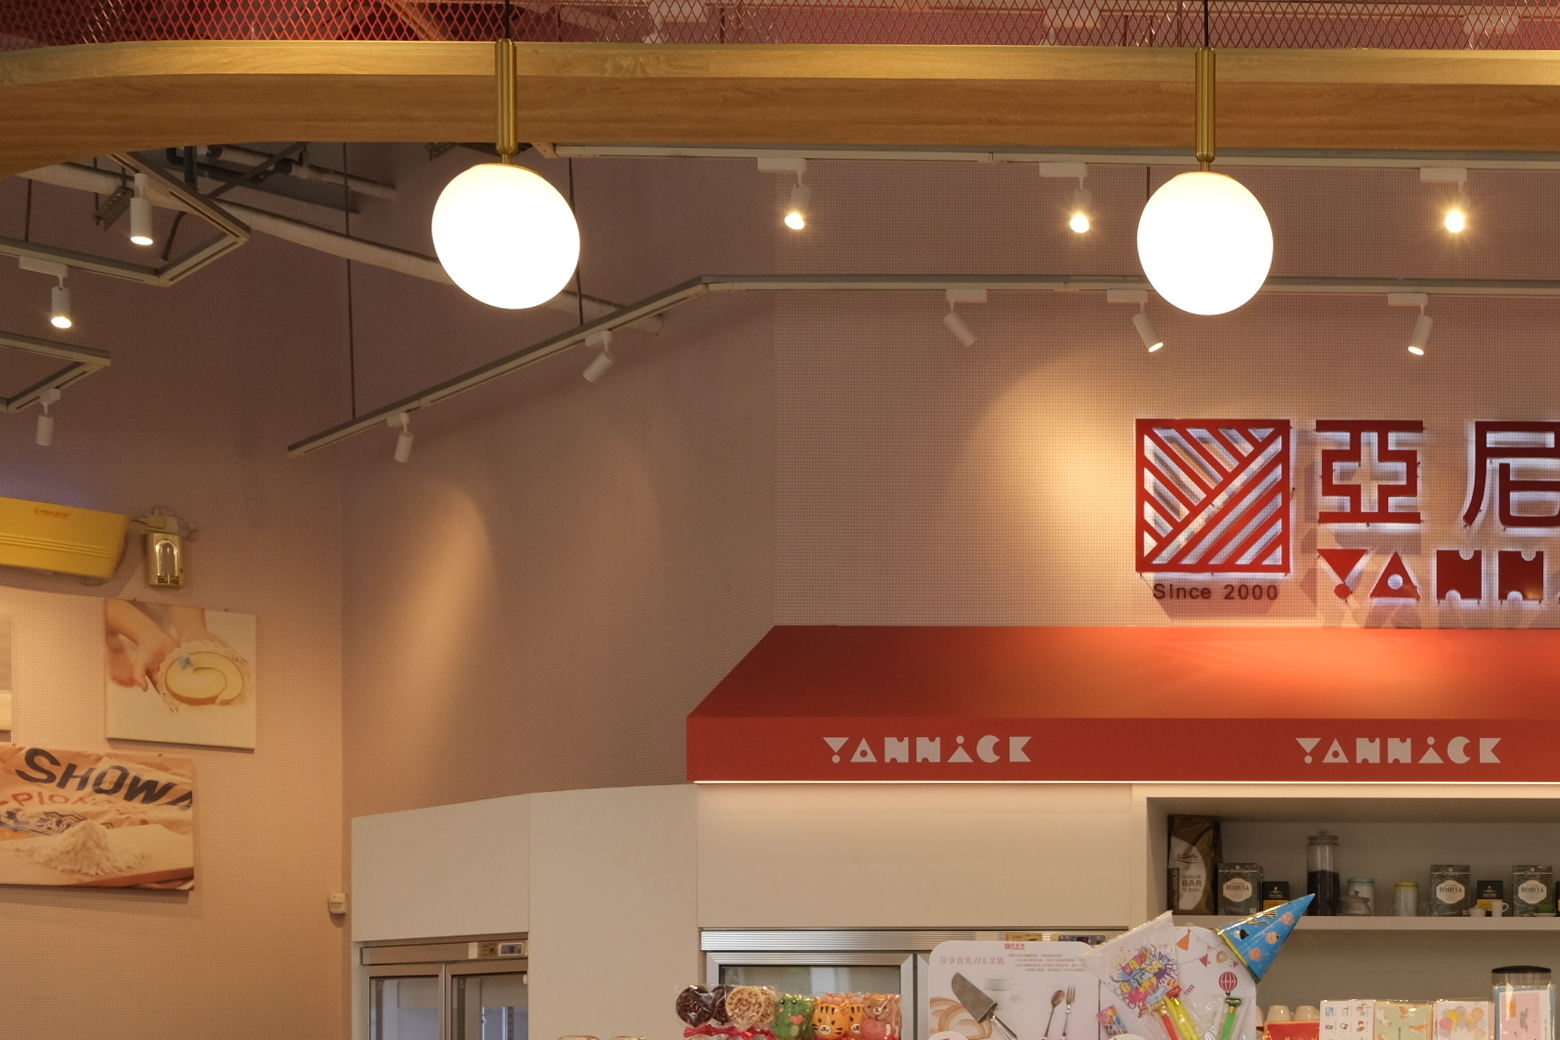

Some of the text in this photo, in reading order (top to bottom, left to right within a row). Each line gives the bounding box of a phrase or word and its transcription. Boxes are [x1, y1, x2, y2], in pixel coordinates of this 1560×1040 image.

[1153, 582, 1279, 600] Since 2000
[823, 735, 1033, 765] YANNICK
[1295, 736, 1502, 766] YANNICK
[1182, 879, 1202, 887] BAR
[939, 956, 1005, 966] 分享食光刀&叉匙
